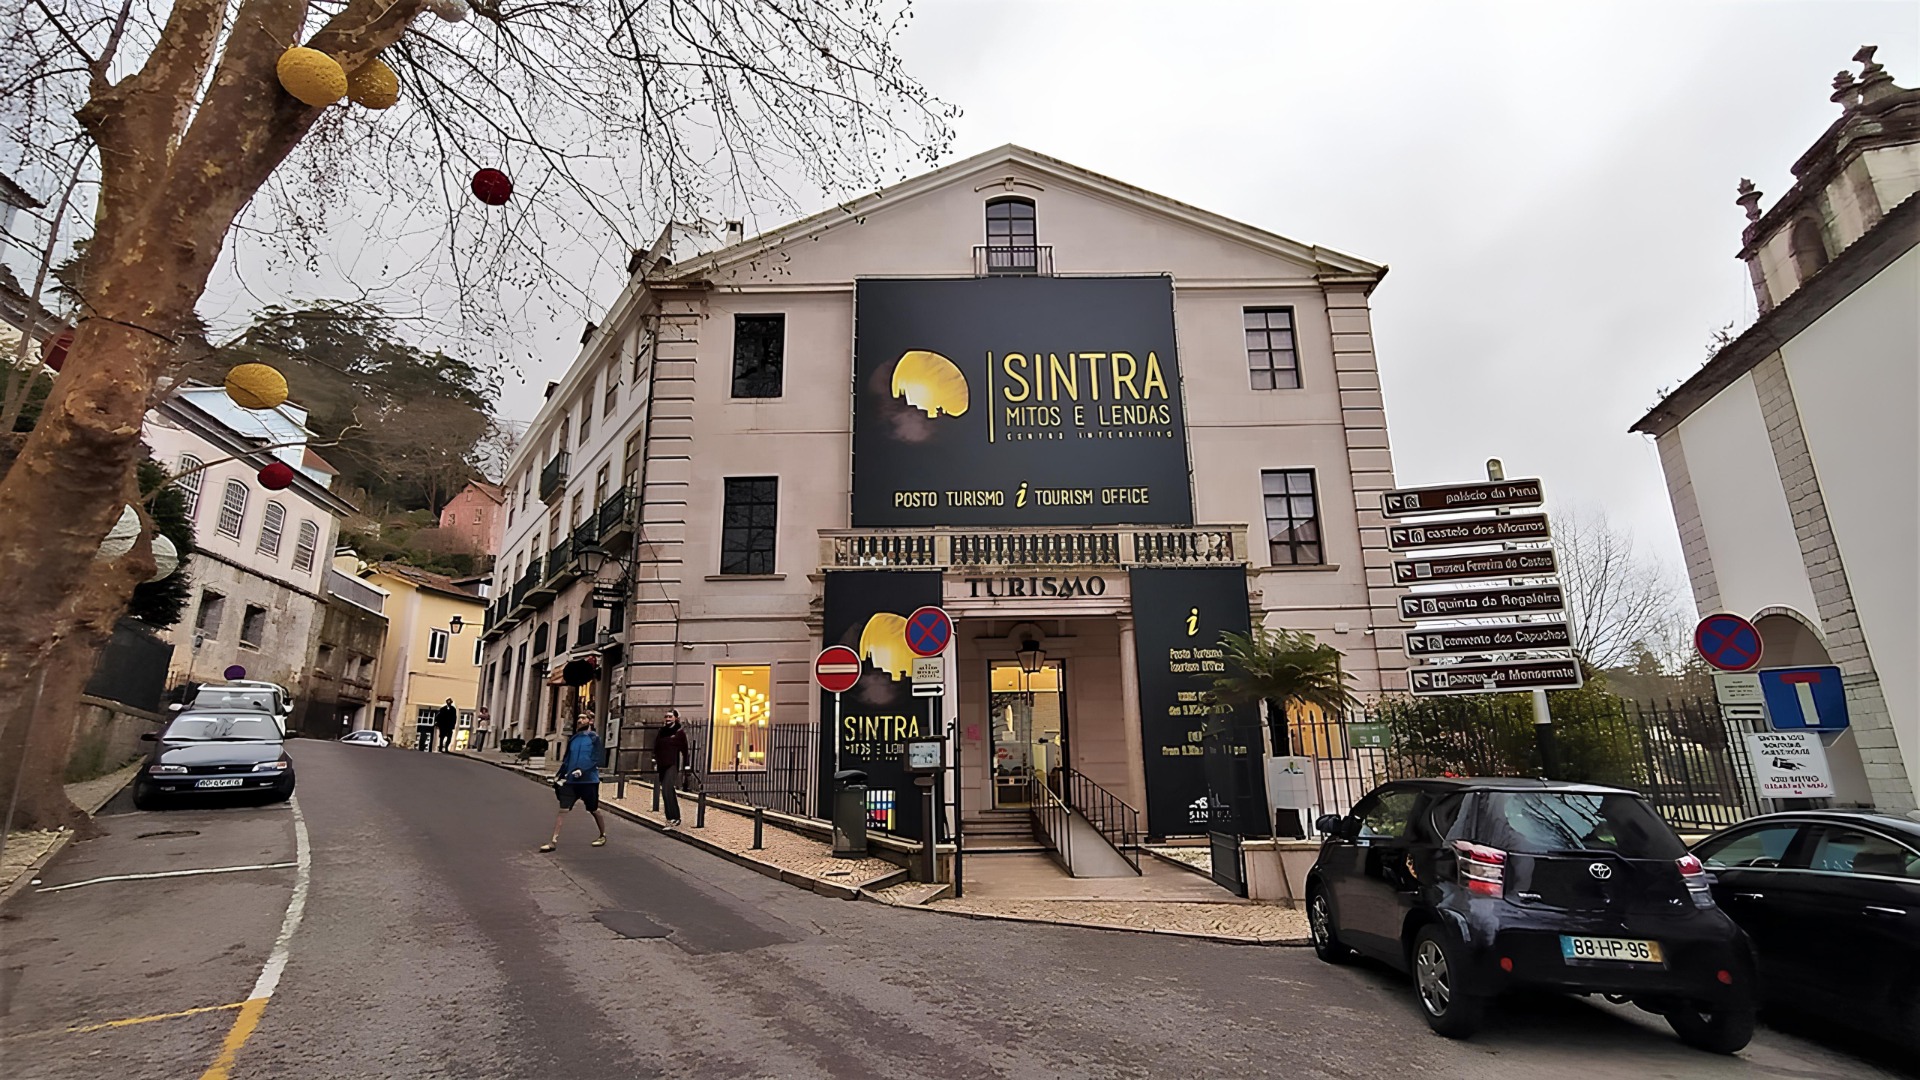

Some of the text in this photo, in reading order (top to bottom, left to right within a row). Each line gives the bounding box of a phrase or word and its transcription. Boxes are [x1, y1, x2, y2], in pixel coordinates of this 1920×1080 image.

[1003, 351, 1169, 402] SINTRA
[1005, 404, 1171, 427] MITOS E LENDAS
[895, 491, 938, 508] POSTO
[945, 490, 1005, 507] TURISMO
[1034, 489, 1094, 506] TOURISM
[1101, 487, 1149, 505] OFFICE
[1426, 526, 1469, 539] castelo
[1472, 525, 1495, 536] dos
[964, 575, 1106, 598] TURISMO
[1438, 597, 1478, 612] quinta
[1481, 596, 1498, 607] da
[843, 715, 919, 742] SINTRA
